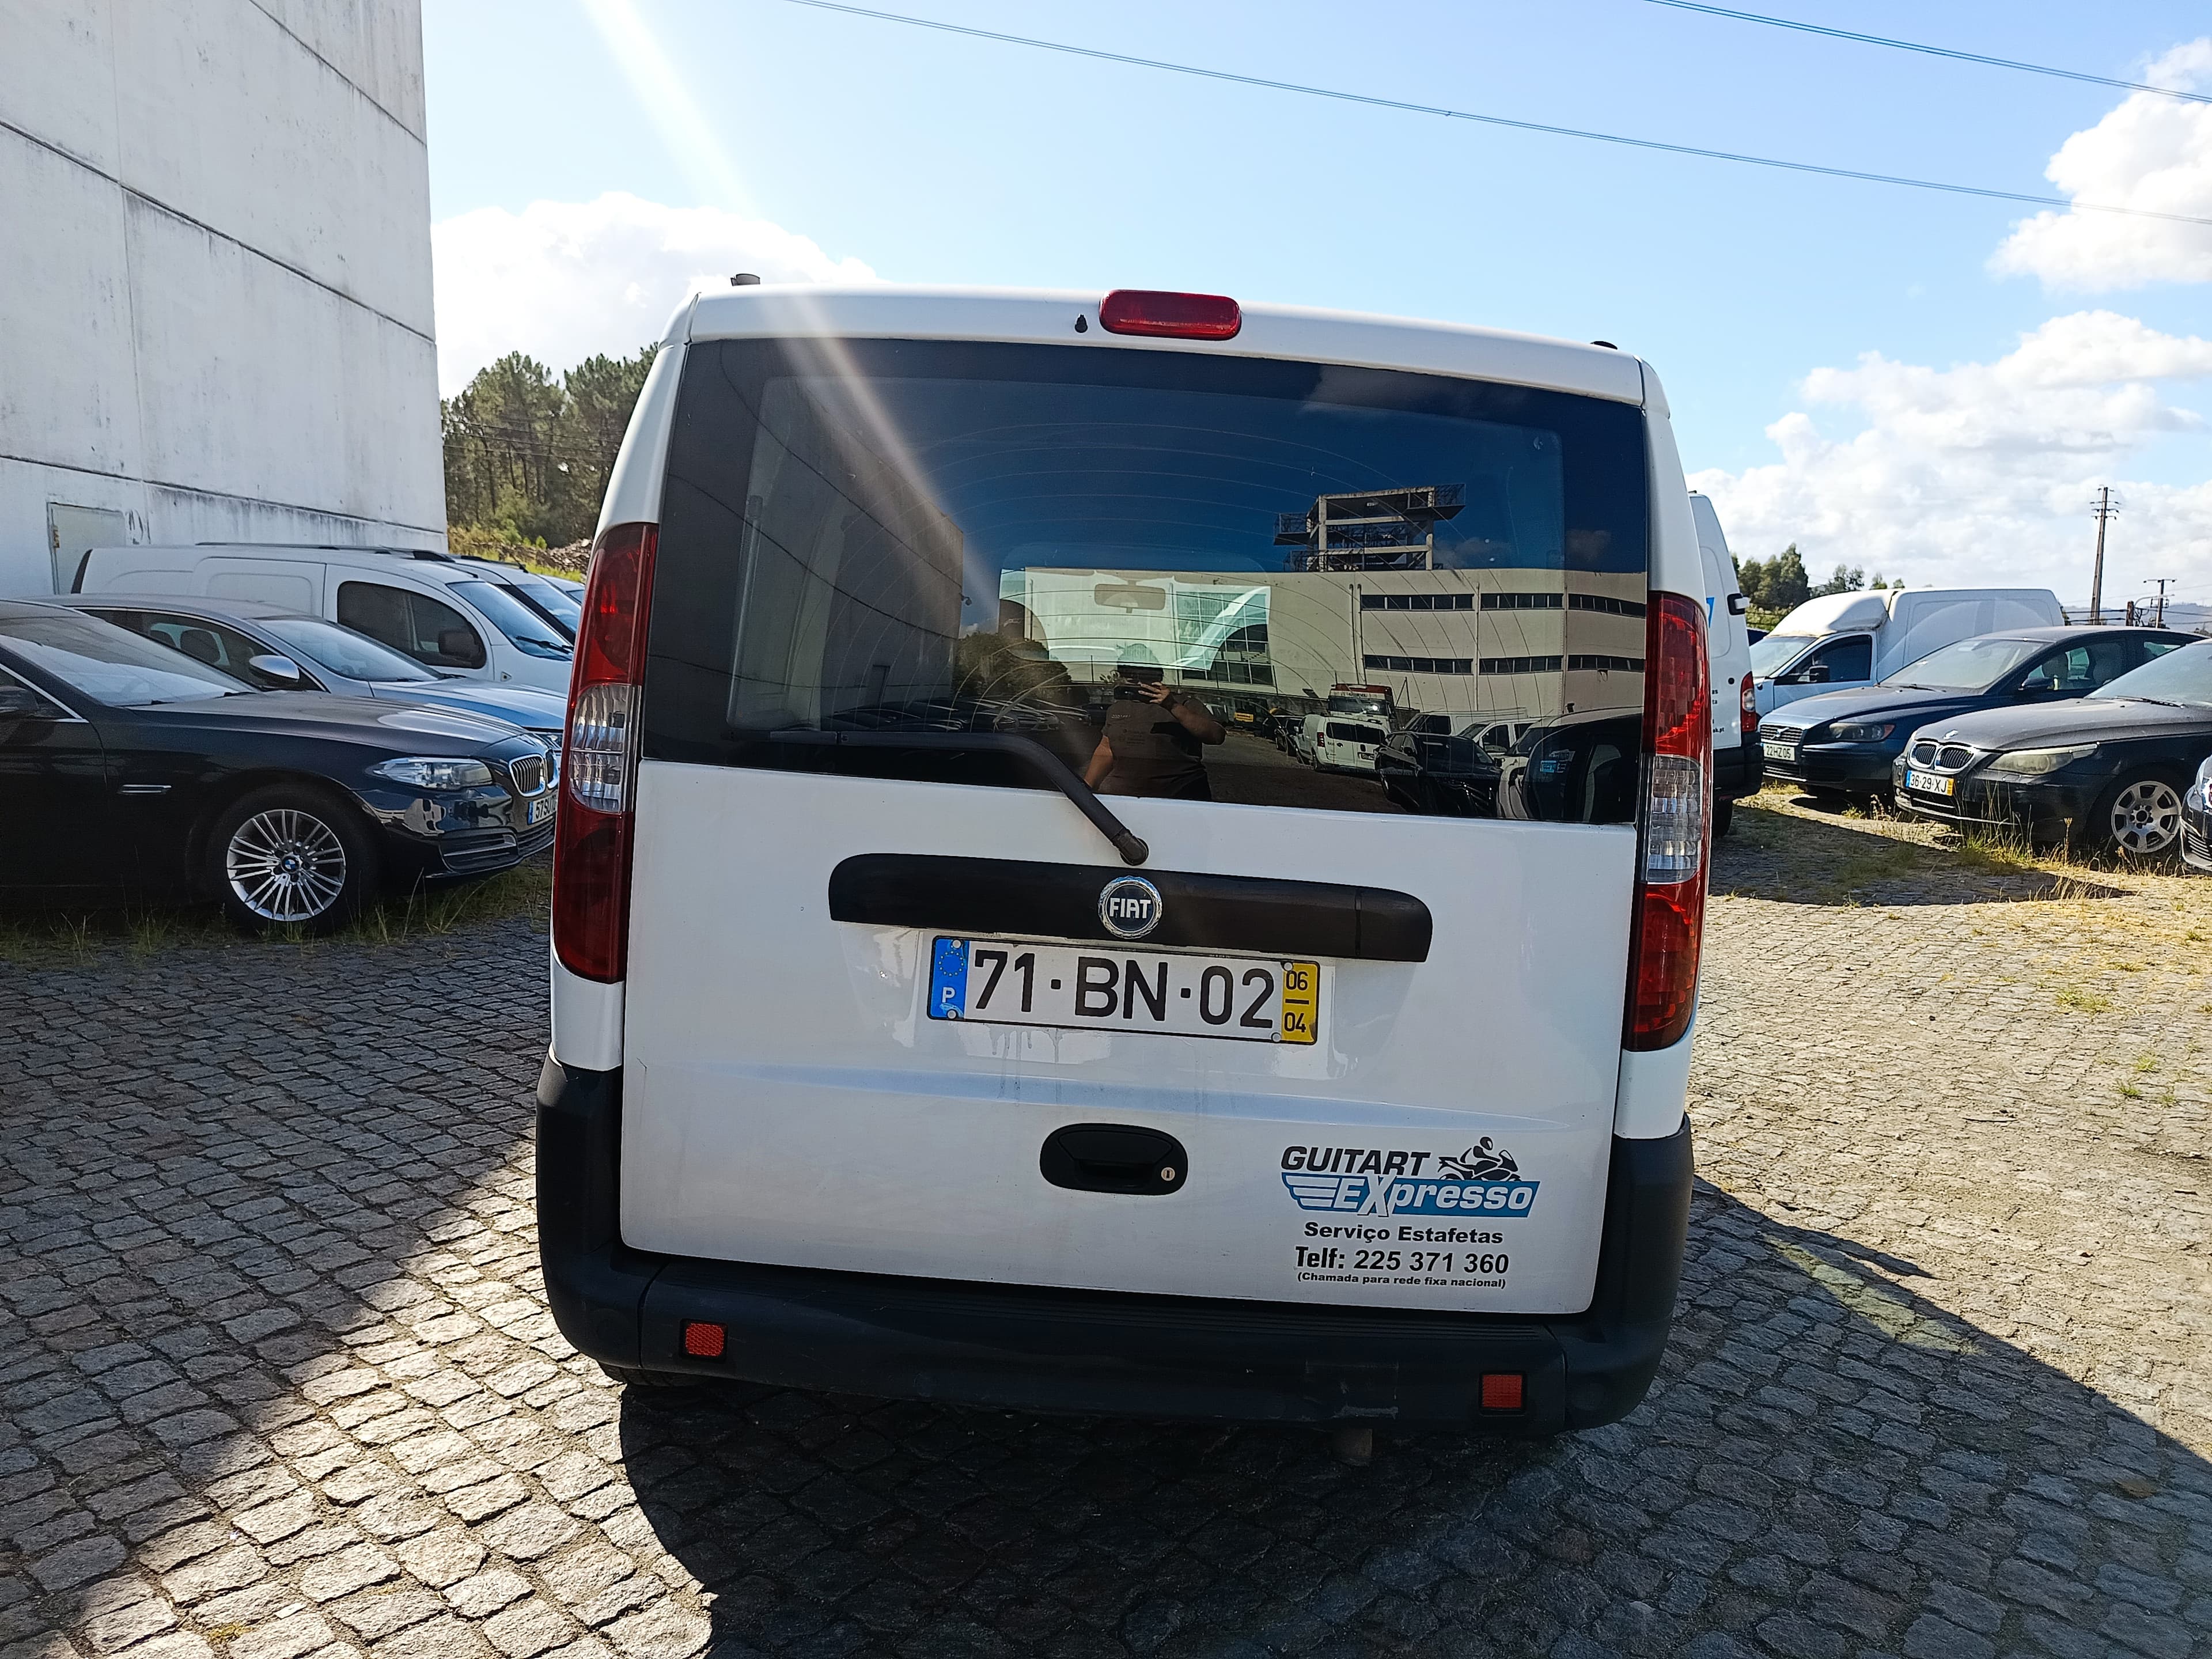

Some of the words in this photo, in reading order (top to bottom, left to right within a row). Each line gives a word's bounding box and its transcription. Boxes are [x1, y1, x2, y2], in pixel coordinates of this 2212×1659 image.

[1109, 897, 1152, 919] FIAT
[1286, 970, 1309, 991] 06
[941, 987, 956, 1003] P
[1283, 1011, 1307, 1033] 04
[1281, 1145, 1431, 1176] GUITART
[1333, 1176, 1533, 1218] EXpresso
[1304, 1222, 1391, 1244] Serviço
[1398, 1226, 1503, 1244] Estafetas
[1295, 1245, 1346, 1269] Telf:
[1353, 1249, 1401, 1271] 225
[1409, 1252, 1454, 1272] 371
[1464, 1253, 1509, 1274] 360
[1297, 1272, 1359, 1283] (Chamada
[1362, 1276, 1390, 1286] para
[1393, 1275, 1421, 1285] rede
[1424, 1277, 1447, 1286] fixa
[1450, 1278, 1506, 1289] nacional)
